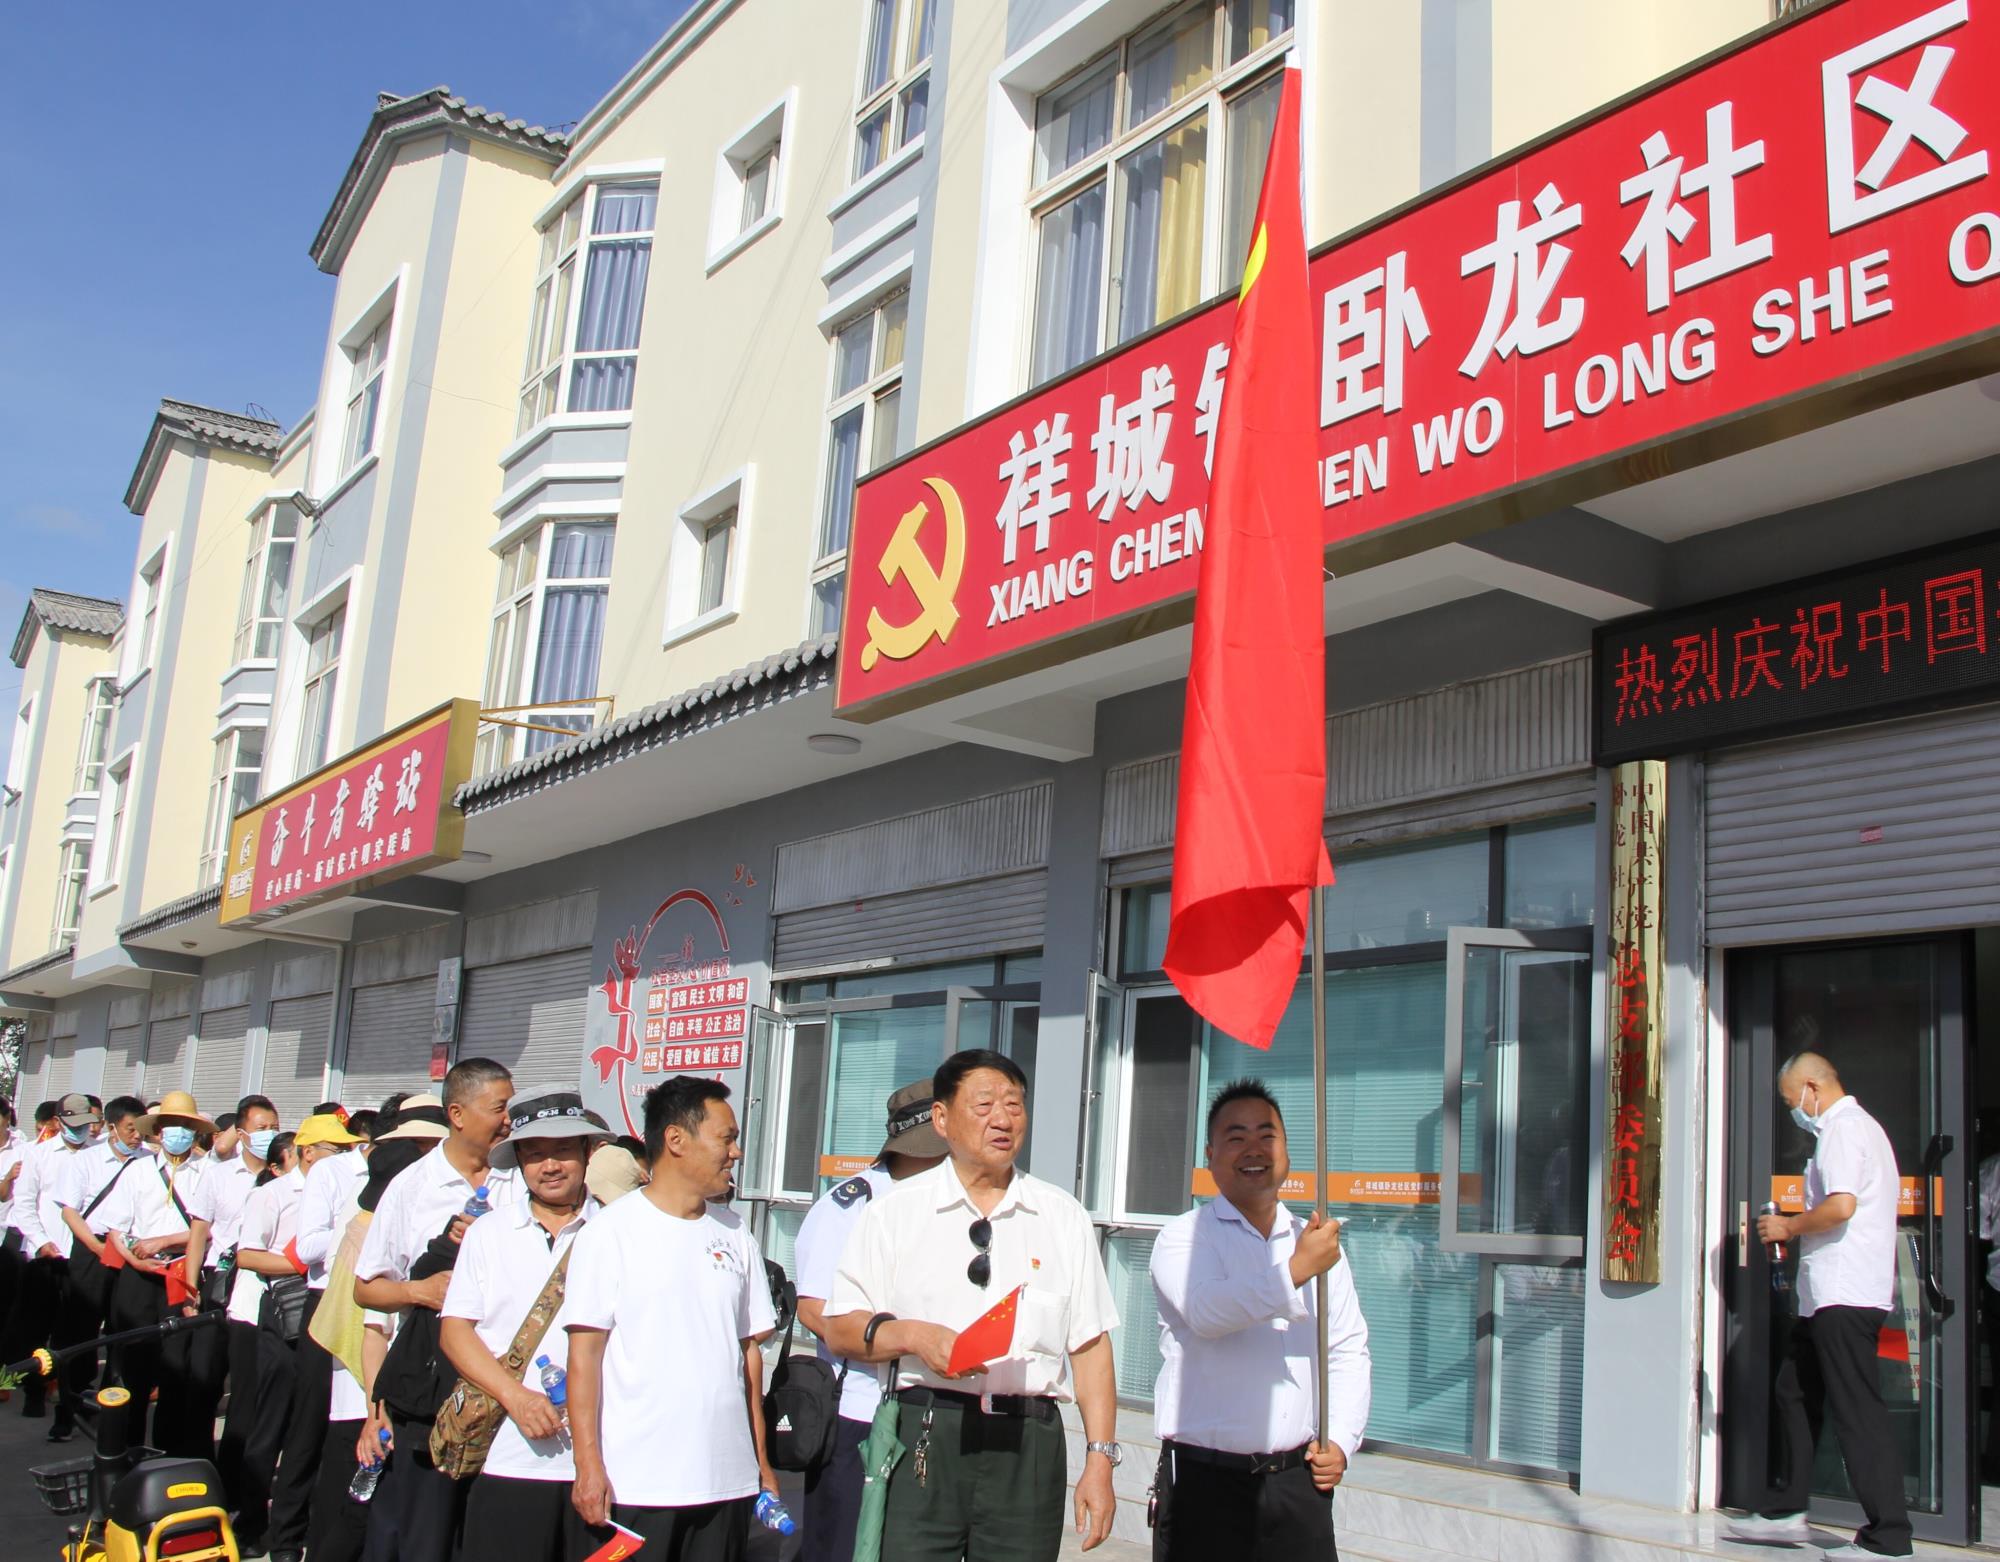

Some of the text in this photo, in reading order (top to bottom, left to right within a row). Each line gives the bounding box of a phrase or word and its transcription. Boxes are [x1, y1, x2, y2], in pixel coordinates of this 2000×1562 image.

[995, 0, 1988, 565] 祥城卧龙社区
[987, 550, 1094, 627] XIANG
[1110, 505, 1206, 582] CHEN
[1320, 437, 1388, 508] EN
[1413, 396, 1504, 474] WO
[1543, 317, 1716, 430] LONG
[1751, 248, 1893, 356] SHE
[1614, 567, 2000, 727] 热烈庆祝中国
[271, 748, 422, 867] 奋斗者驿站
[1630, 782, 1654, 930] 中国共产党
[643, 1044, 739, 1067] 公民 爱国 敬业 诚信 友善
[647, 1014, 741, 1038] 社会 自由 平等 公正 法治
[648, 982, 744, 1009] 国家 富强 民主 文明 和谐
[1608, 940, 1647, 1262] 总支部委员会
